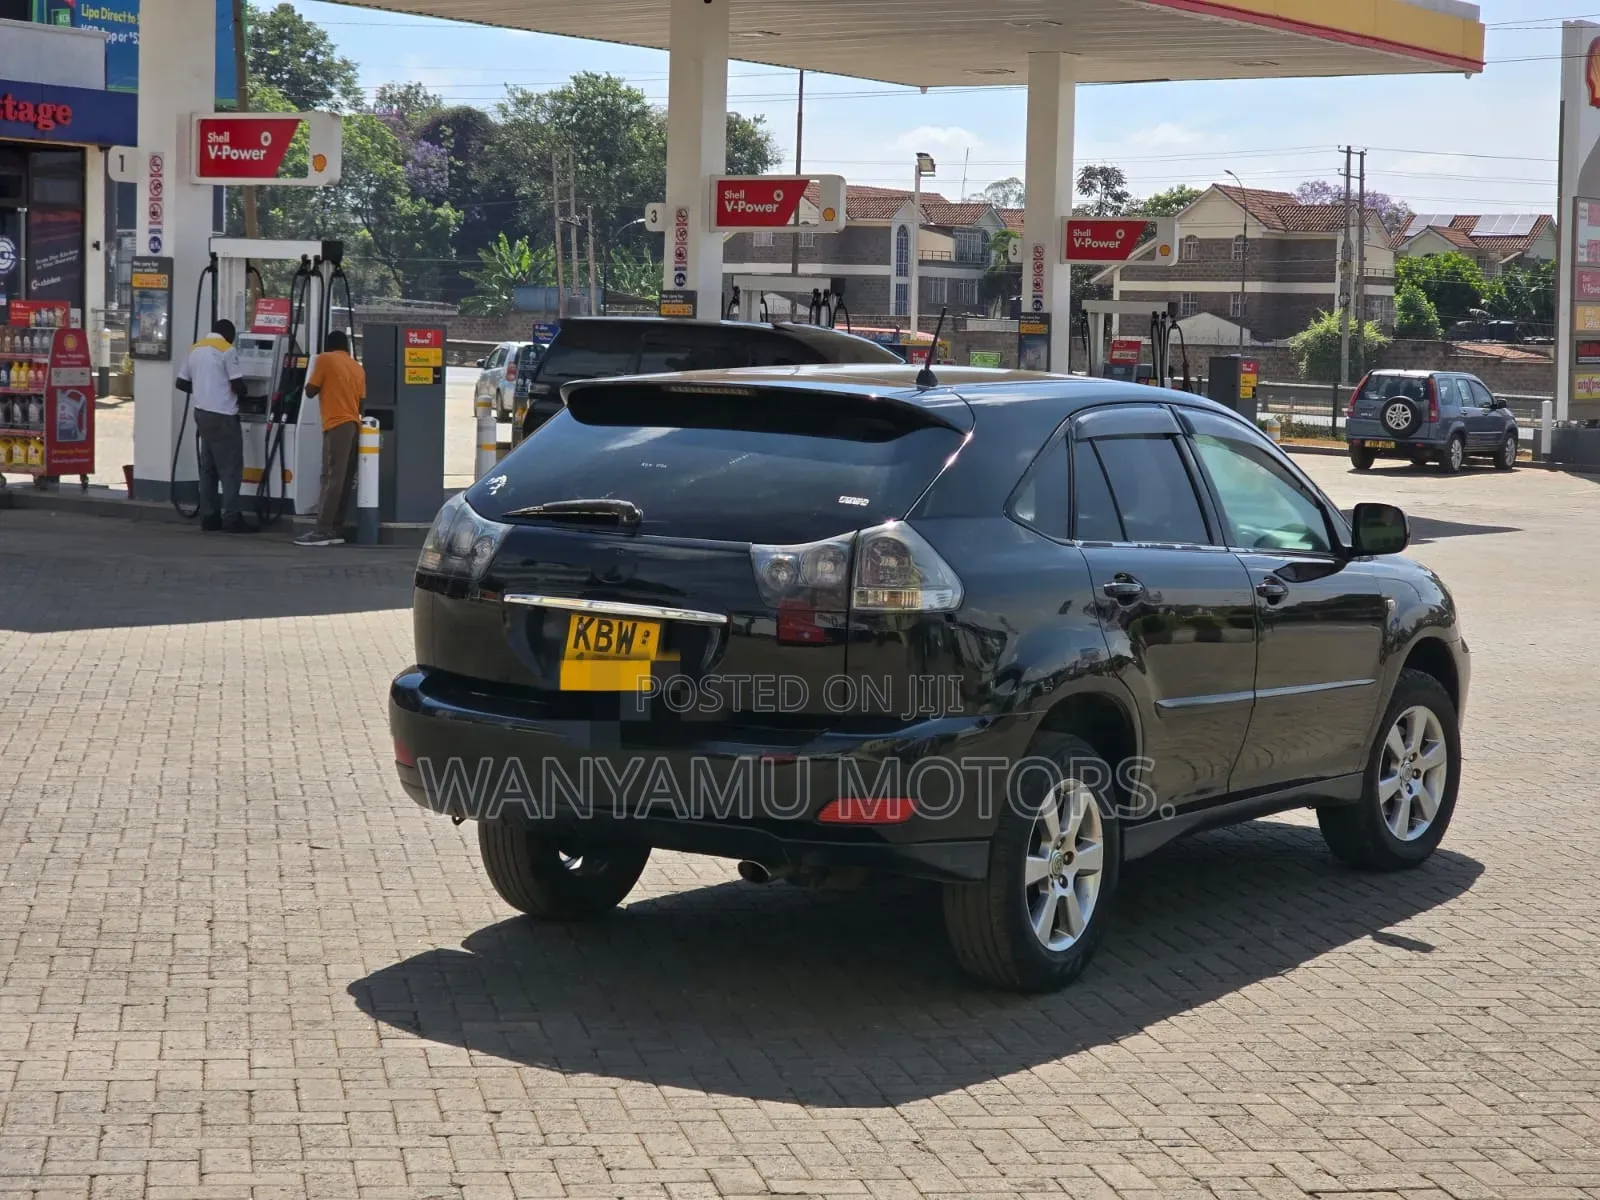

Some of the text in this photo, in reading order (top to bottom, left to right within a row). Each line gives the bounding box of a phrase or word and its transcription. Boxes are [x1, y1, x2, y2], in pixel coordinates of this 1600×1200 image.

[101, 7, 126, 22] Direct
[119, 34, 127, 43] or
[0, 93, 72, 130] tage
[207, 131, 230, 143] Shell
[208, 145, 267, 160] V-Power
[118, 154, 125, 172] 1
[725, 189, 745, 199] Shell
[725, 200, 779, 213] V-Power
[651, 210, 658, 224] 3
[1073, 228, 1091, 237] Shell
[1073, 238, 1121, 249] V-Power
[573, 616, 637, 655] KBW
